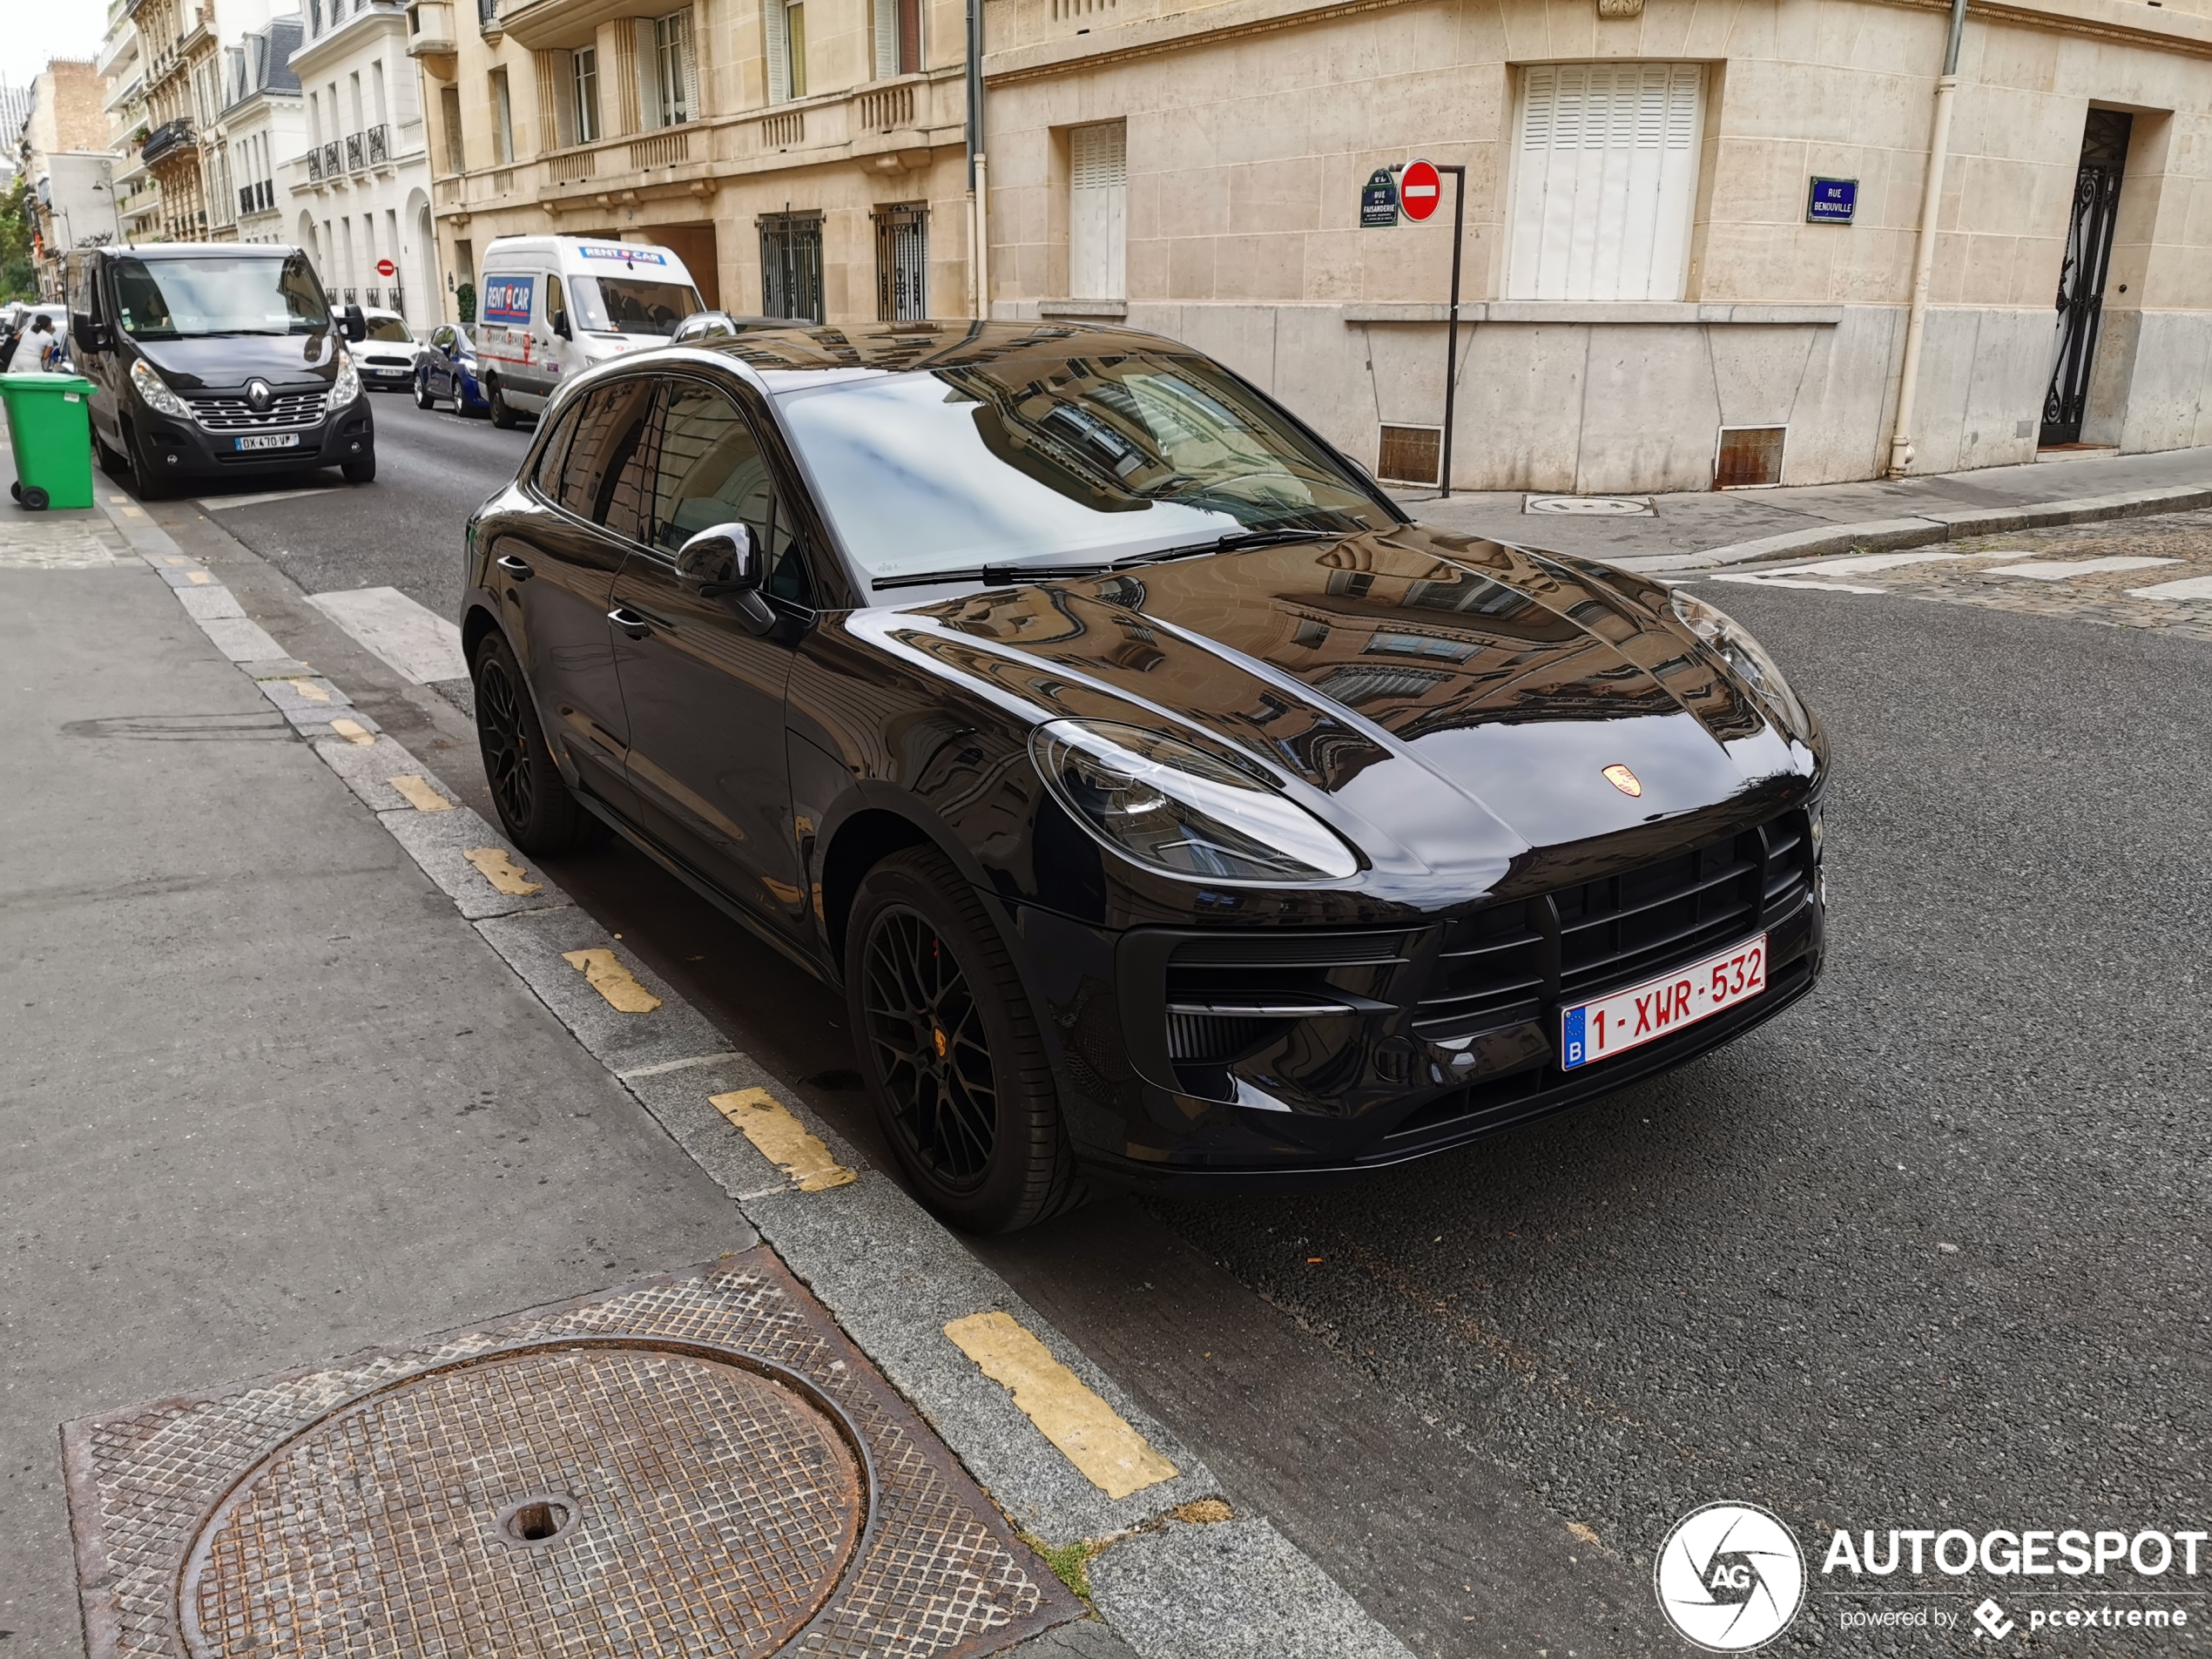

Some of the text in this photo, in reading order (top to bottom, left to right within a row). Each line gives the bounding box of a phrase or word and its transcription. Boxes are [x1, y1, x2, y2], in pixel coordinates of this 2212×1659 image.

[1374, 191, 1386, 199] RUE
[1827, 187, 1842, 199] RUE
[1363, 205, 1395, 213] FAISANDERIE
[1814, 201, 1852, 212] BENOUVILLE
[584, 247, 618, 258] RENT
[632, 251, 661, 264] CAR
[488, 286, 506, 309] RENT
[512, 287, 529, 311] CAR
[1569, 1041, 1582, 1062] B
